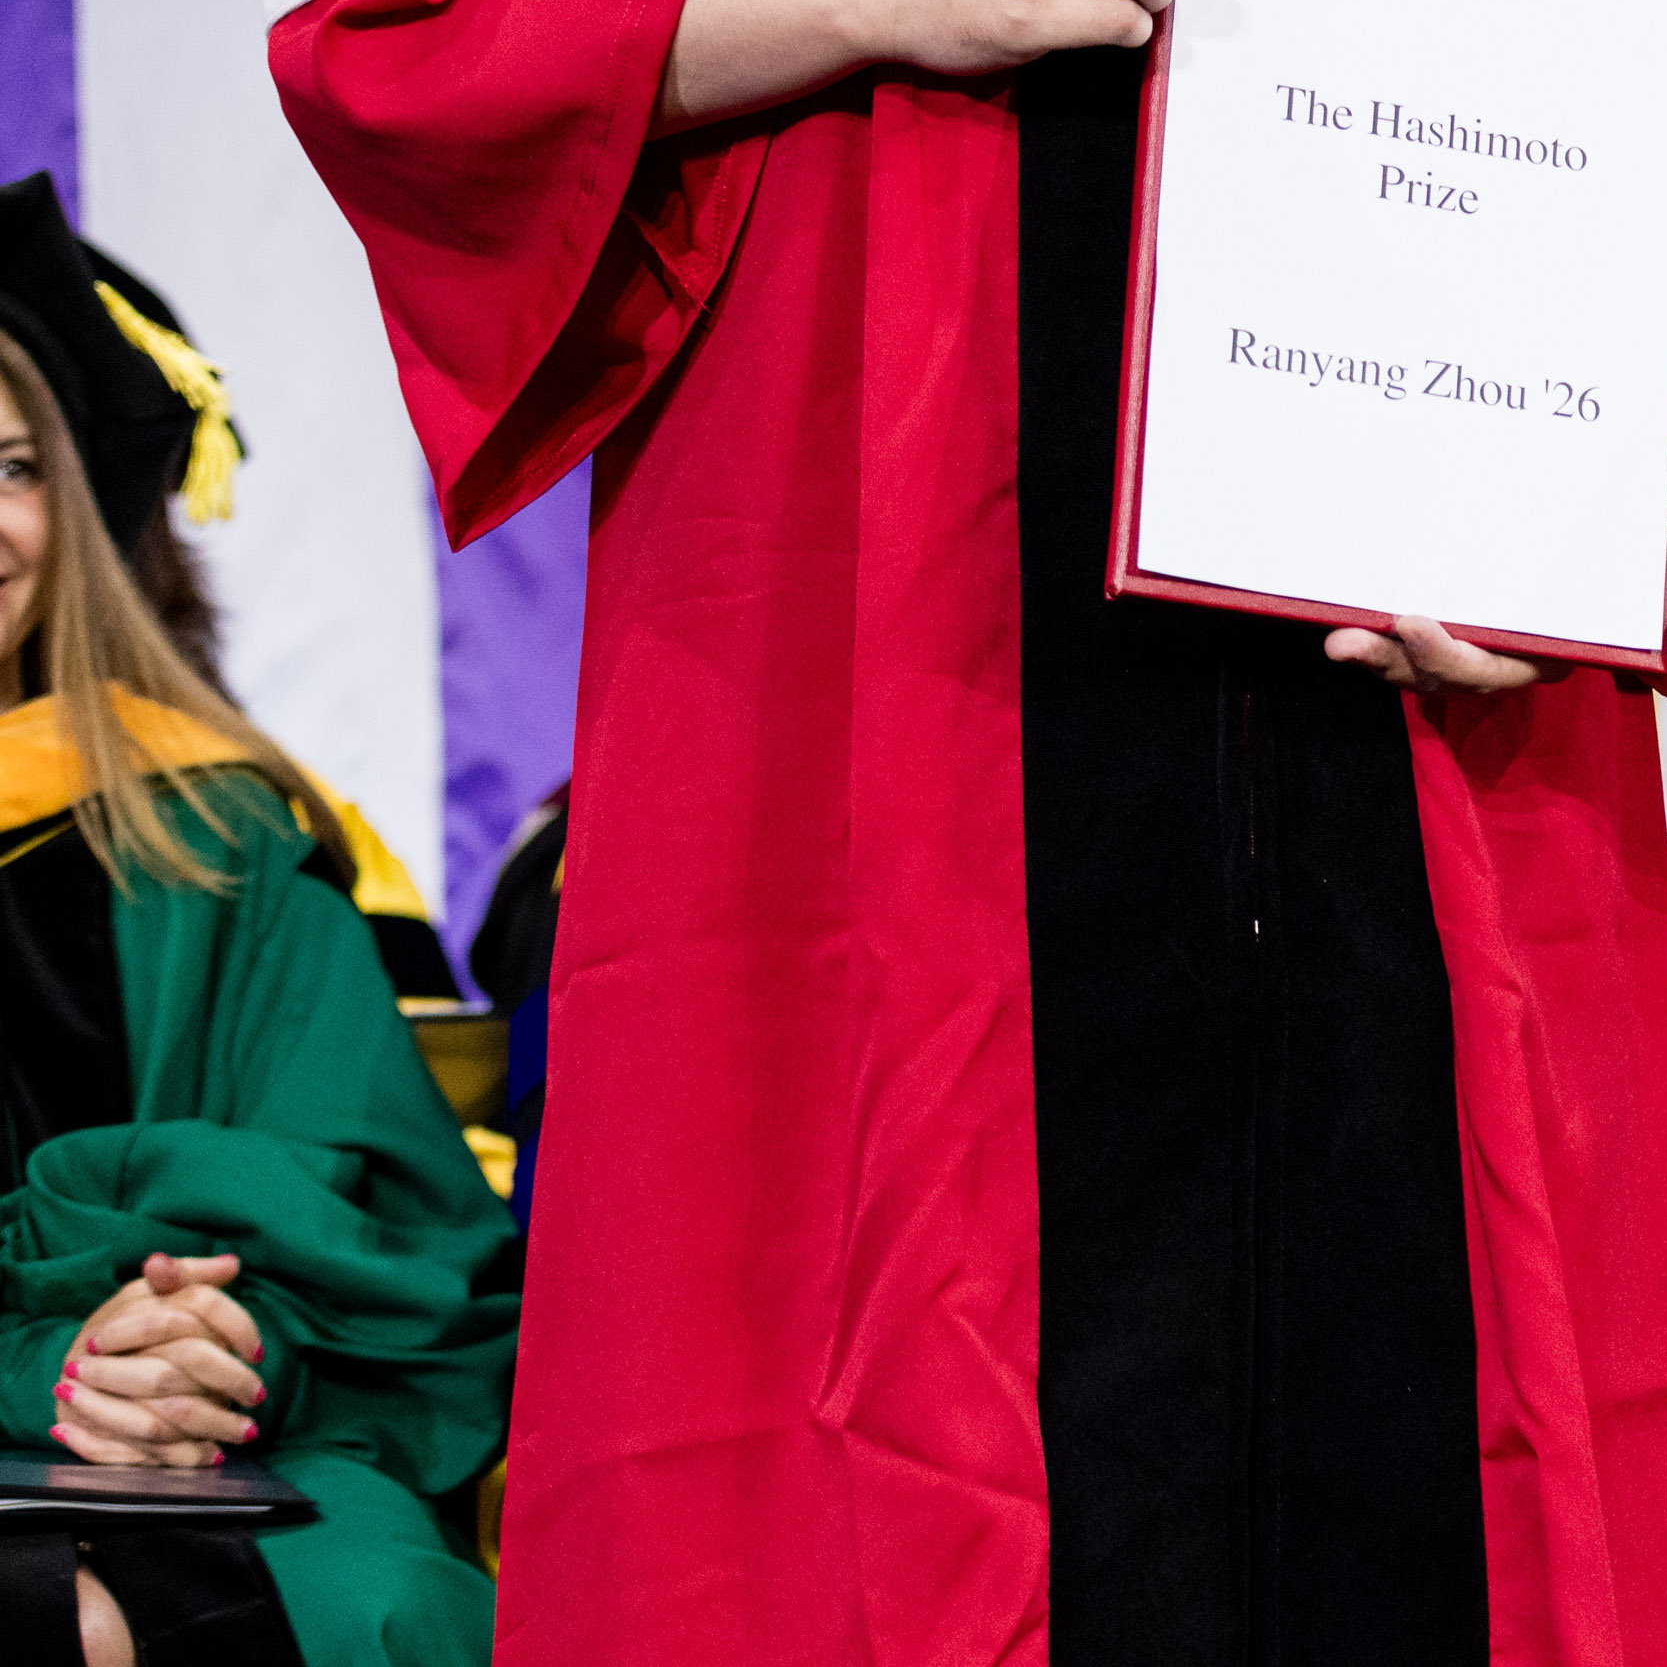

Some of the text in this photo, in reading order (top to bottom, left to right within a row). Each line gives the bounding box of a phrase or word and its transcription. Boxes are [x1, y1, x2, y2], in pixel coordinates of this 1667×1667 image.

[1276, 84, 1587, 171] The Hashimoto
[1377, 164, 1478, 214] Prize
[1227, 328, 1600, 422] Ranyang Zhou '26
